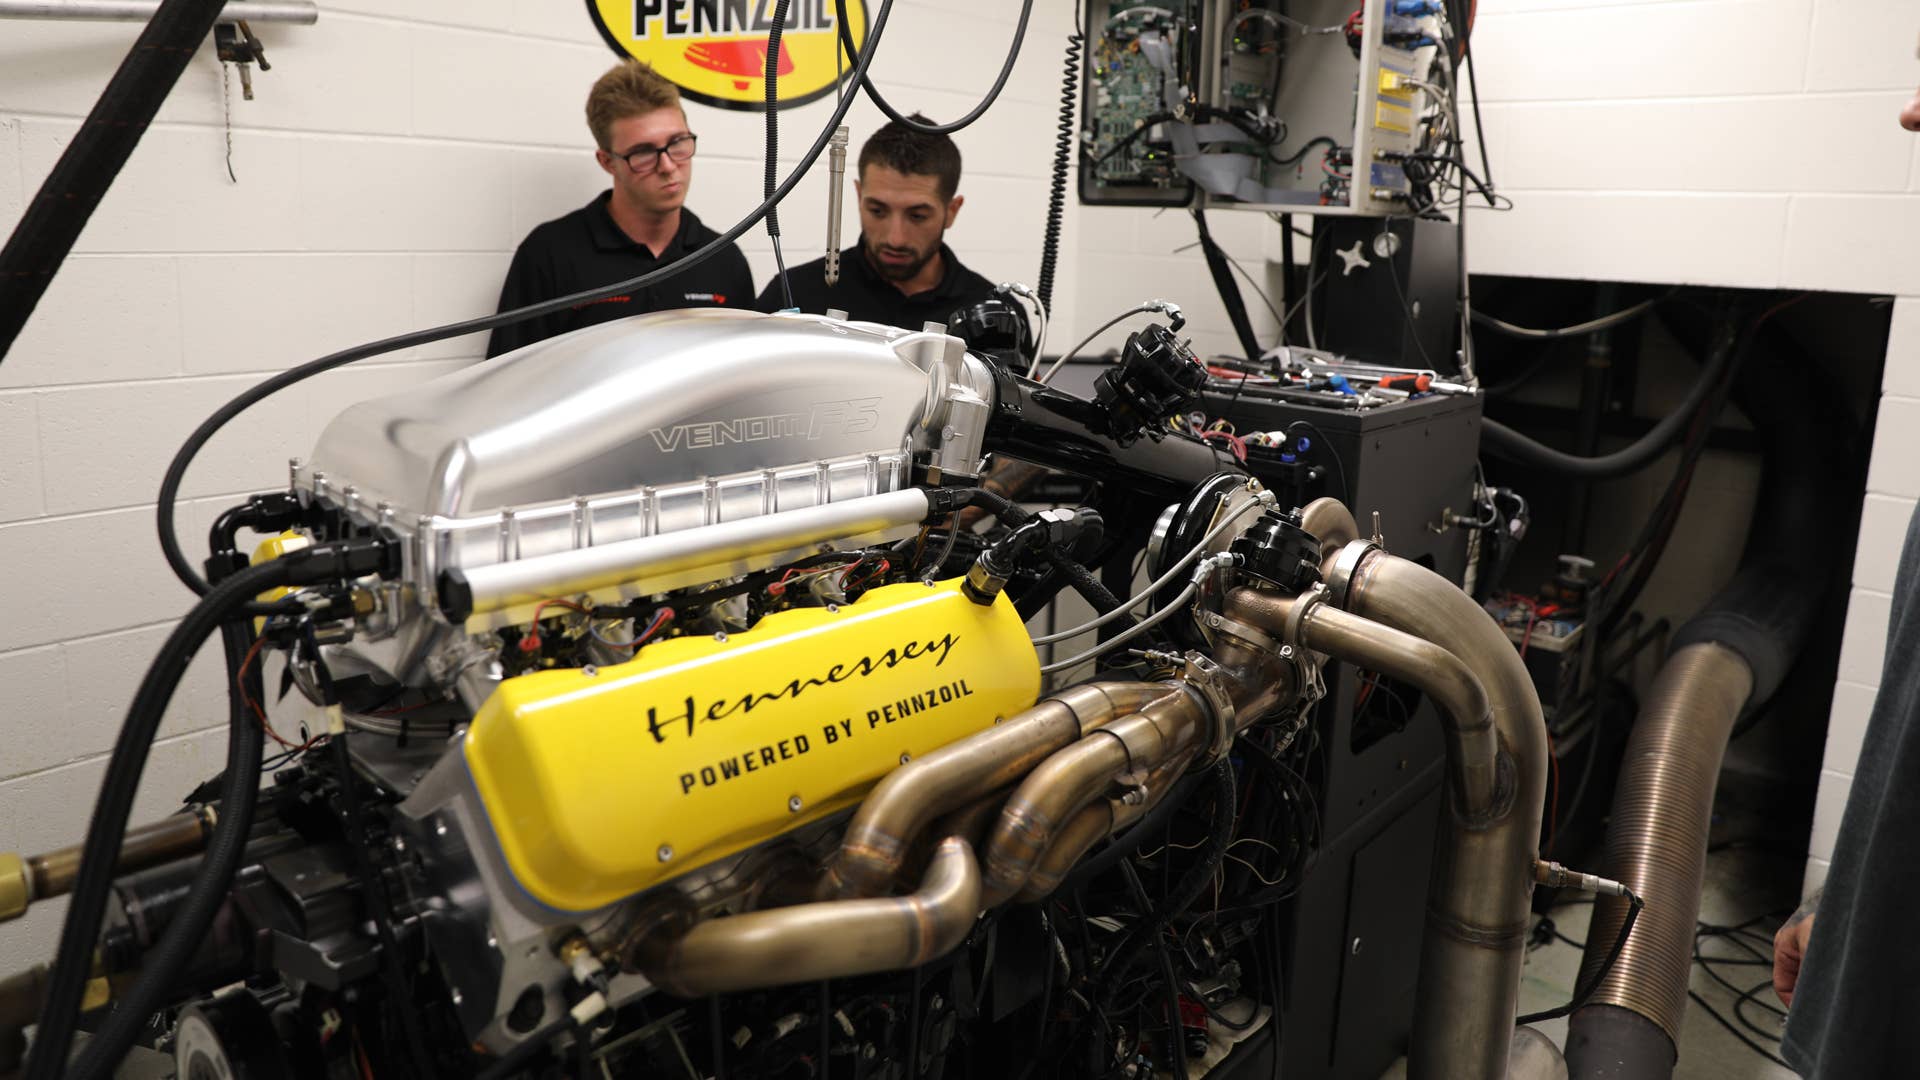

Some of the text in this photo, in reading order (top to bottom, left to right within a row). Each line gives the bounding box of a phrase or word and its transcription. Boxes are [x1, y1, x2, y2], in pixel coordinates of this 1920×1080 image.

[646, 632, 961, 744] Hennessey
[680, 678, 974, 794] POWERED BY PENNZOIL
